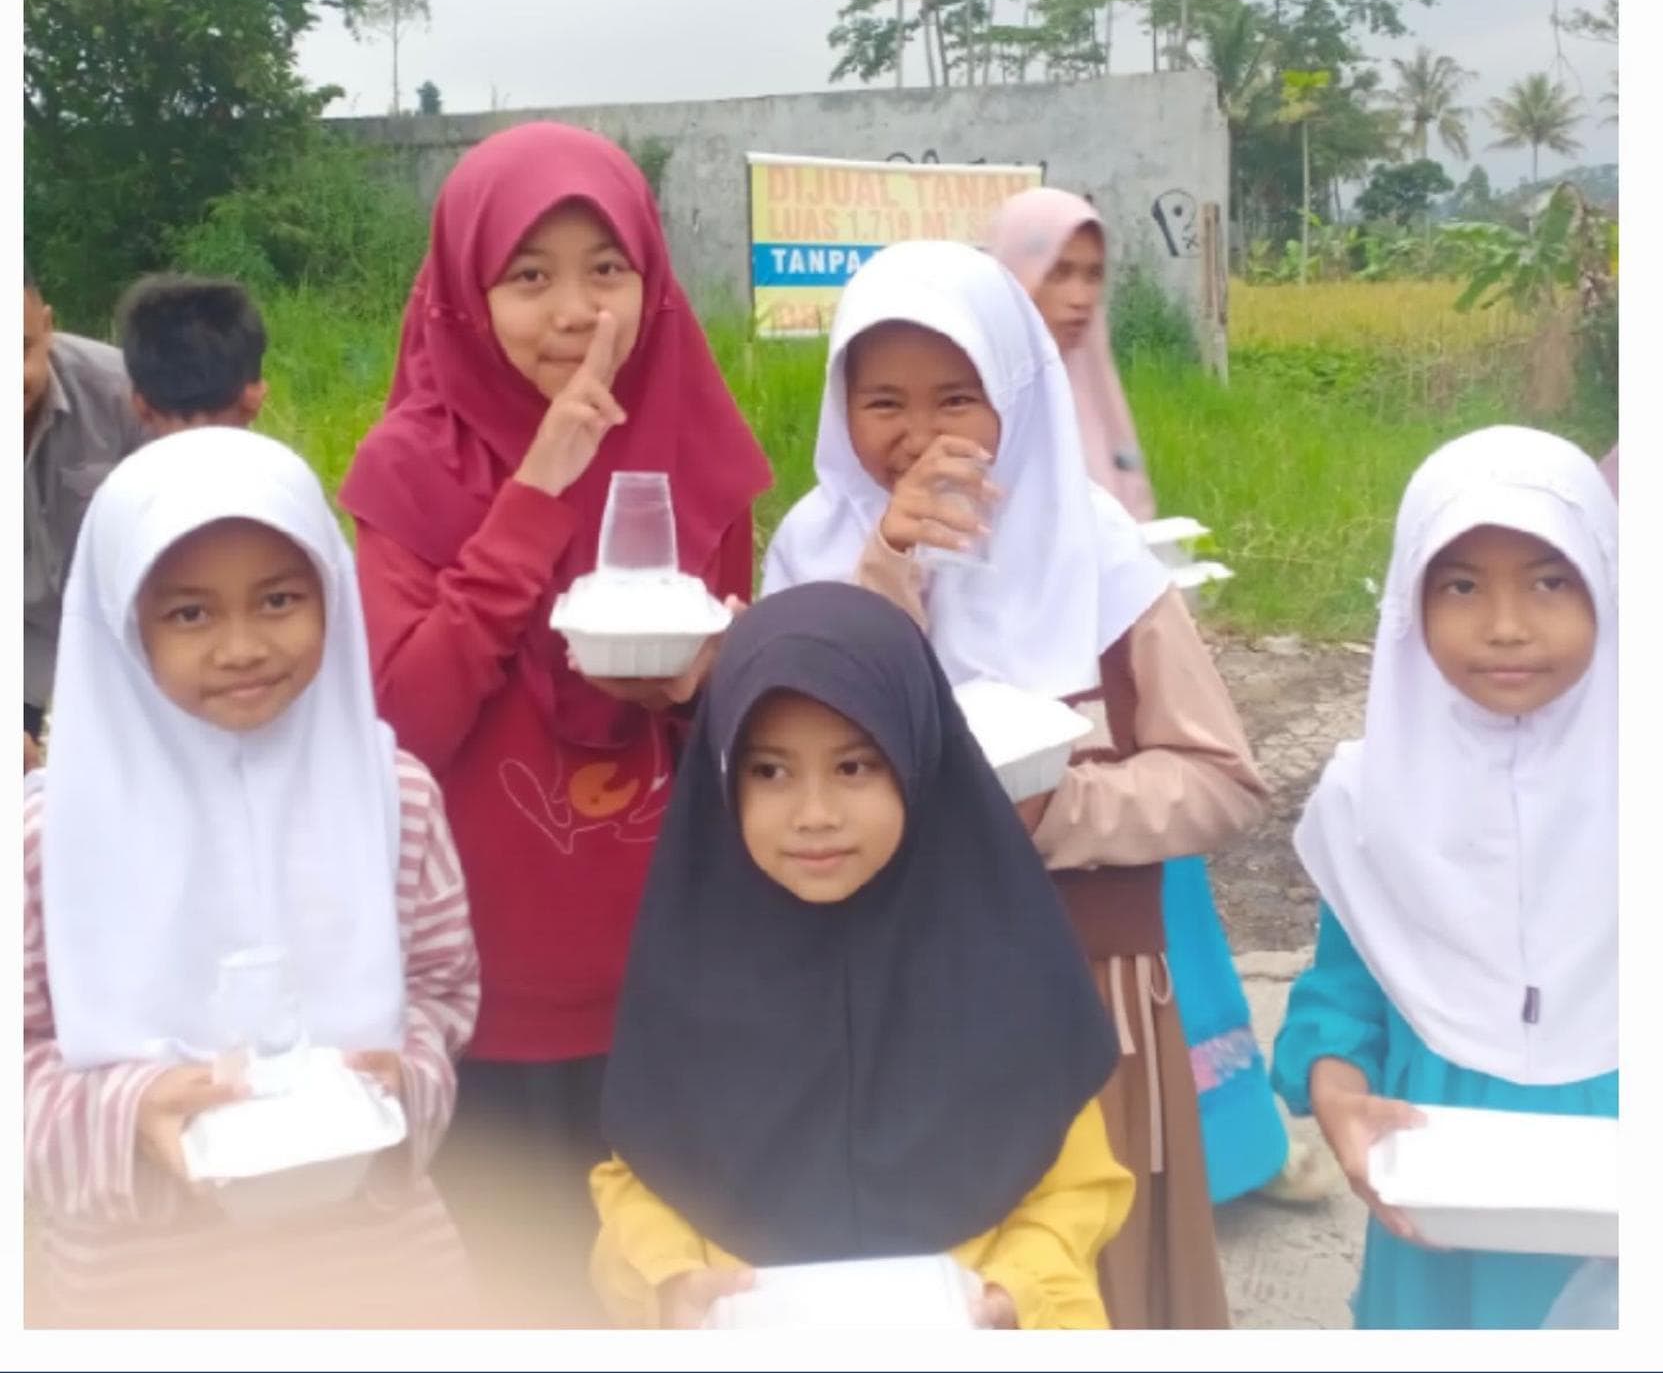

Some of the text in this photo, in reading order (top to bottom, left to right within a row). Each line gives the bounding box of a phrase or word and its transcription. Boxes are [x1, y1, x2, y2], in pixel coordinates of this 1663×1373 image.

[767, 166, 900, 208] DIJUAL
[768, 208, 838, 241] LUAS
[770, 248, 862, 275] TANPA
